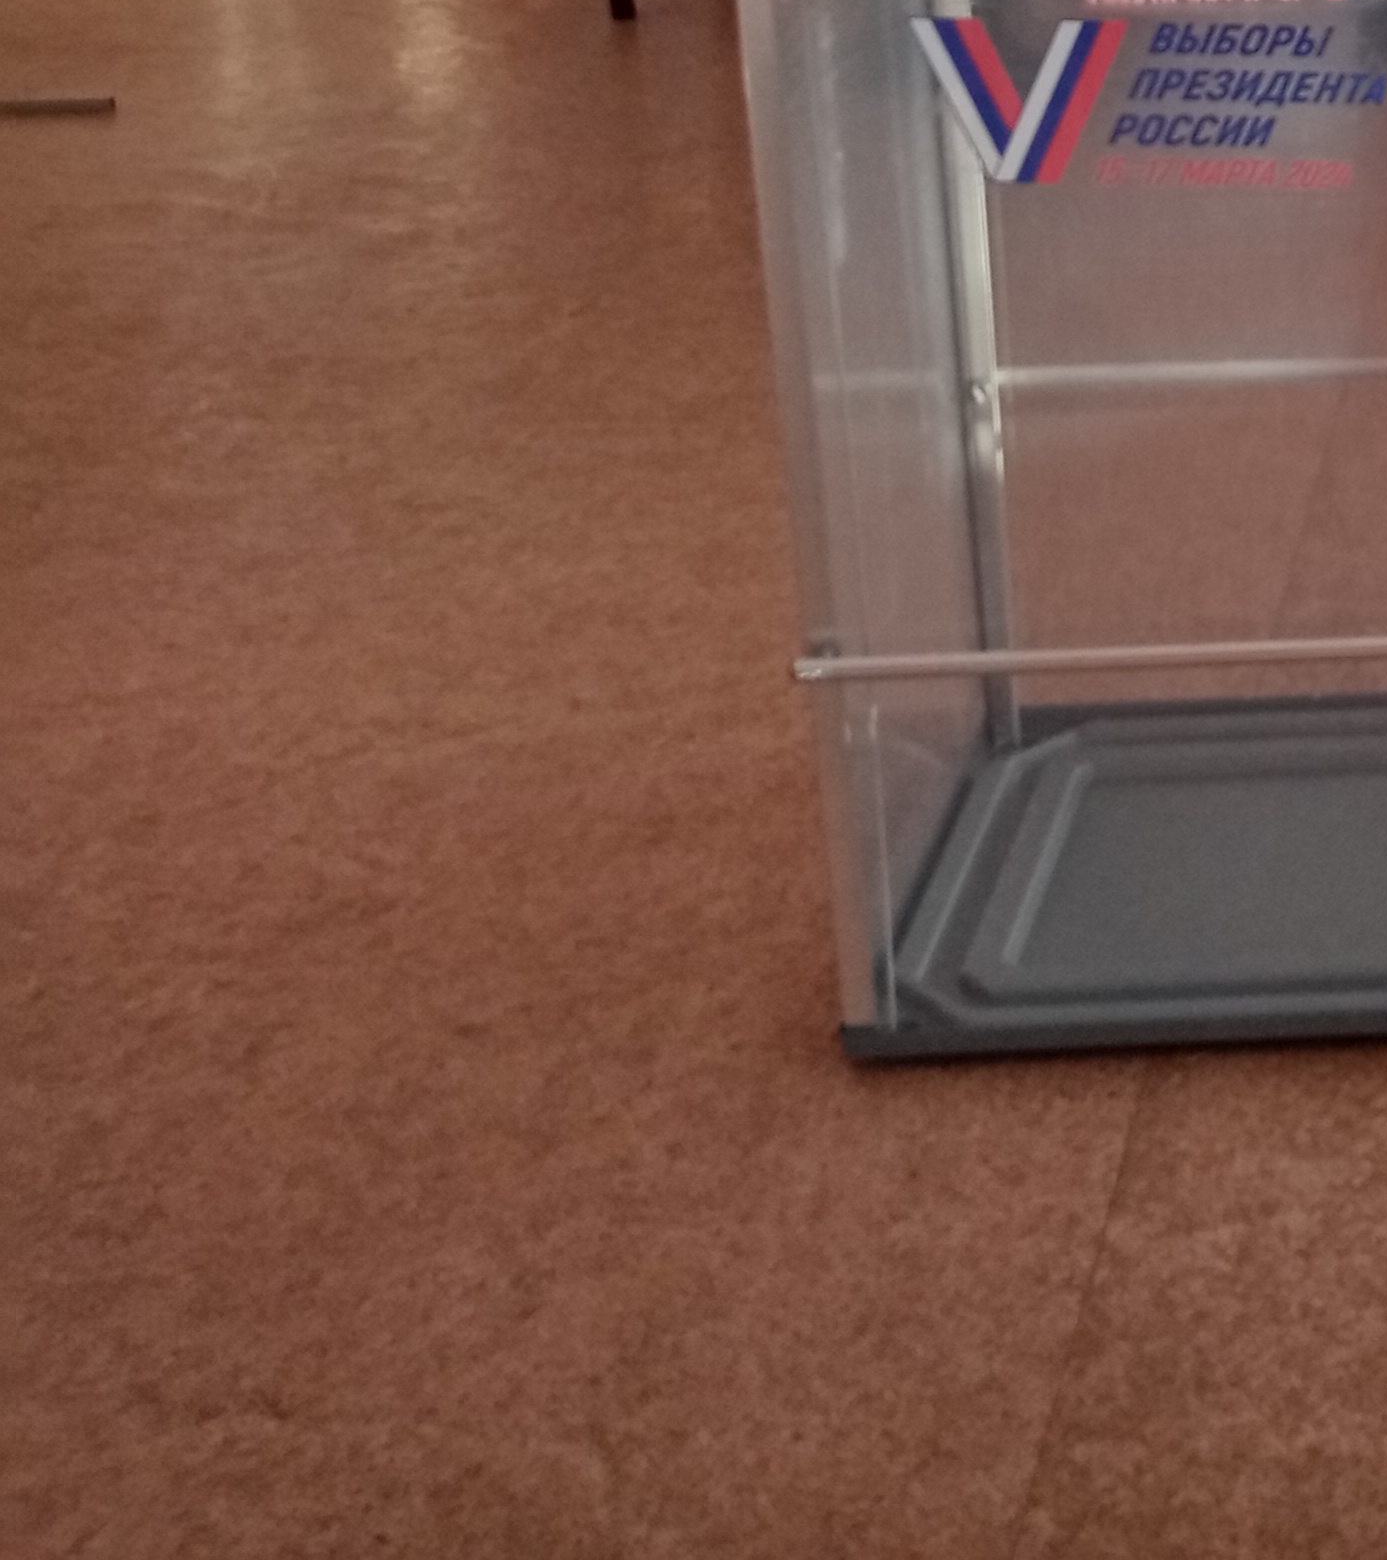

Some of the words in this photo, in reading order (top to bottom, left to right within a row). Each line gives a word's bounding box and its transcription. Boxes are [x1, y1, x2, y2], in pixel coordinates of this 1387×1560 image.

[1148, 21, 1335, 58] ВЫБОРЫ
[1106, 112, 1277, 149] РОССИИ
[1180, 158, 1278, 186] МАРТА
